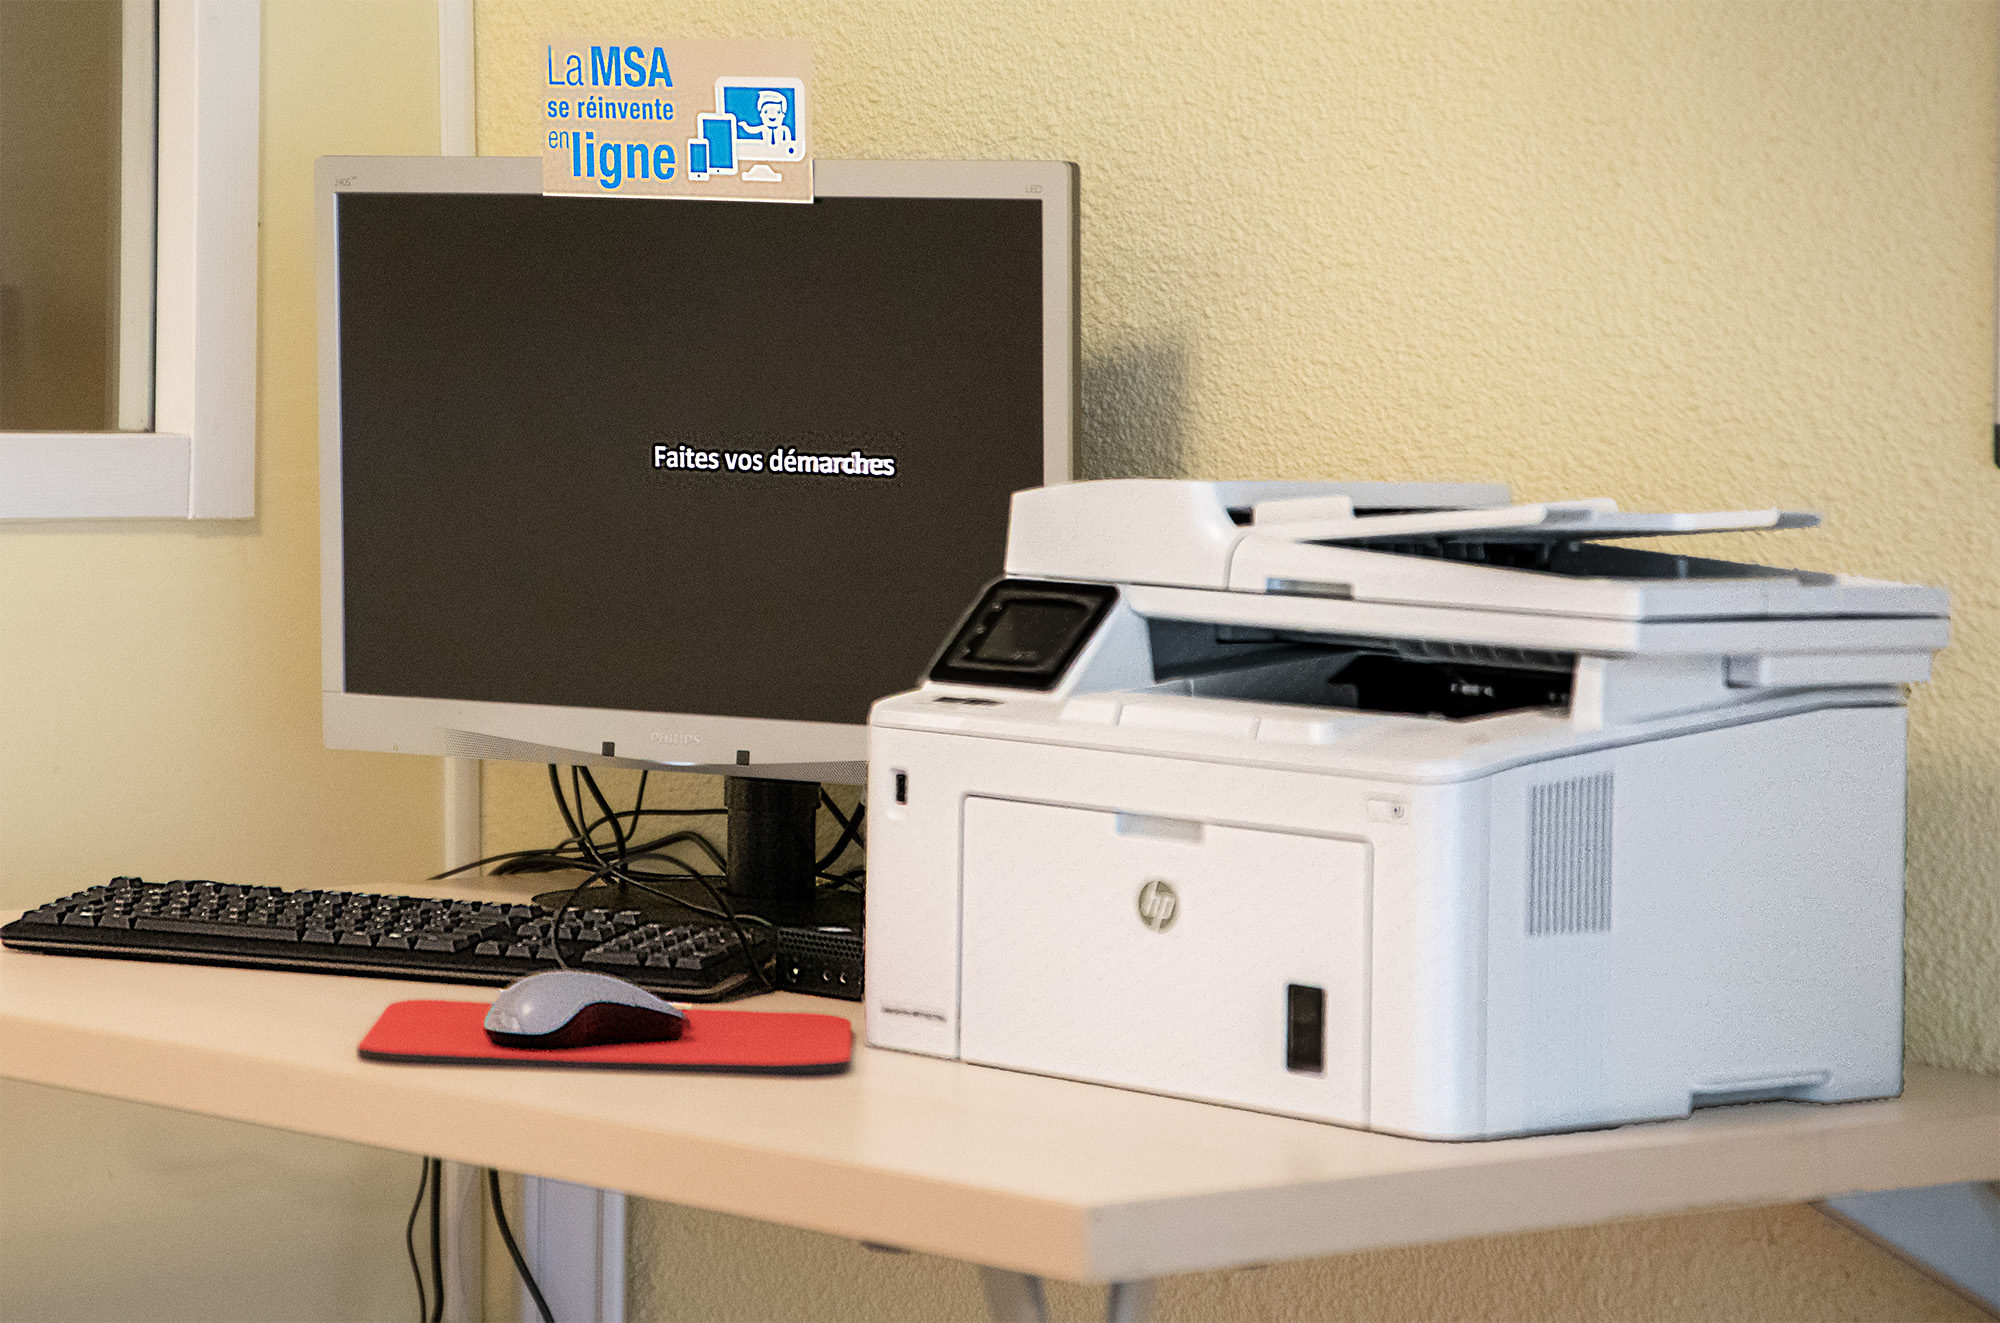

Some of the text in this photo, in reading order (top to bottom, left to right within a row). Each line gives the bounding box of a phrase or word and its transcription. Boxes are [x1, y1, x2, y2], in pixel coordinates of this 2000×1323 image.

[548, 45, 673, 88] La MSA
[547, 95, 674, 121] se réinvente
[548, 130, 676, 189] en ligne
[654, 445, 896, 476] Faites vos démarches
[650, 732, 701, 746] PHILIPS
[1144, 881, 1176, 932] hp
